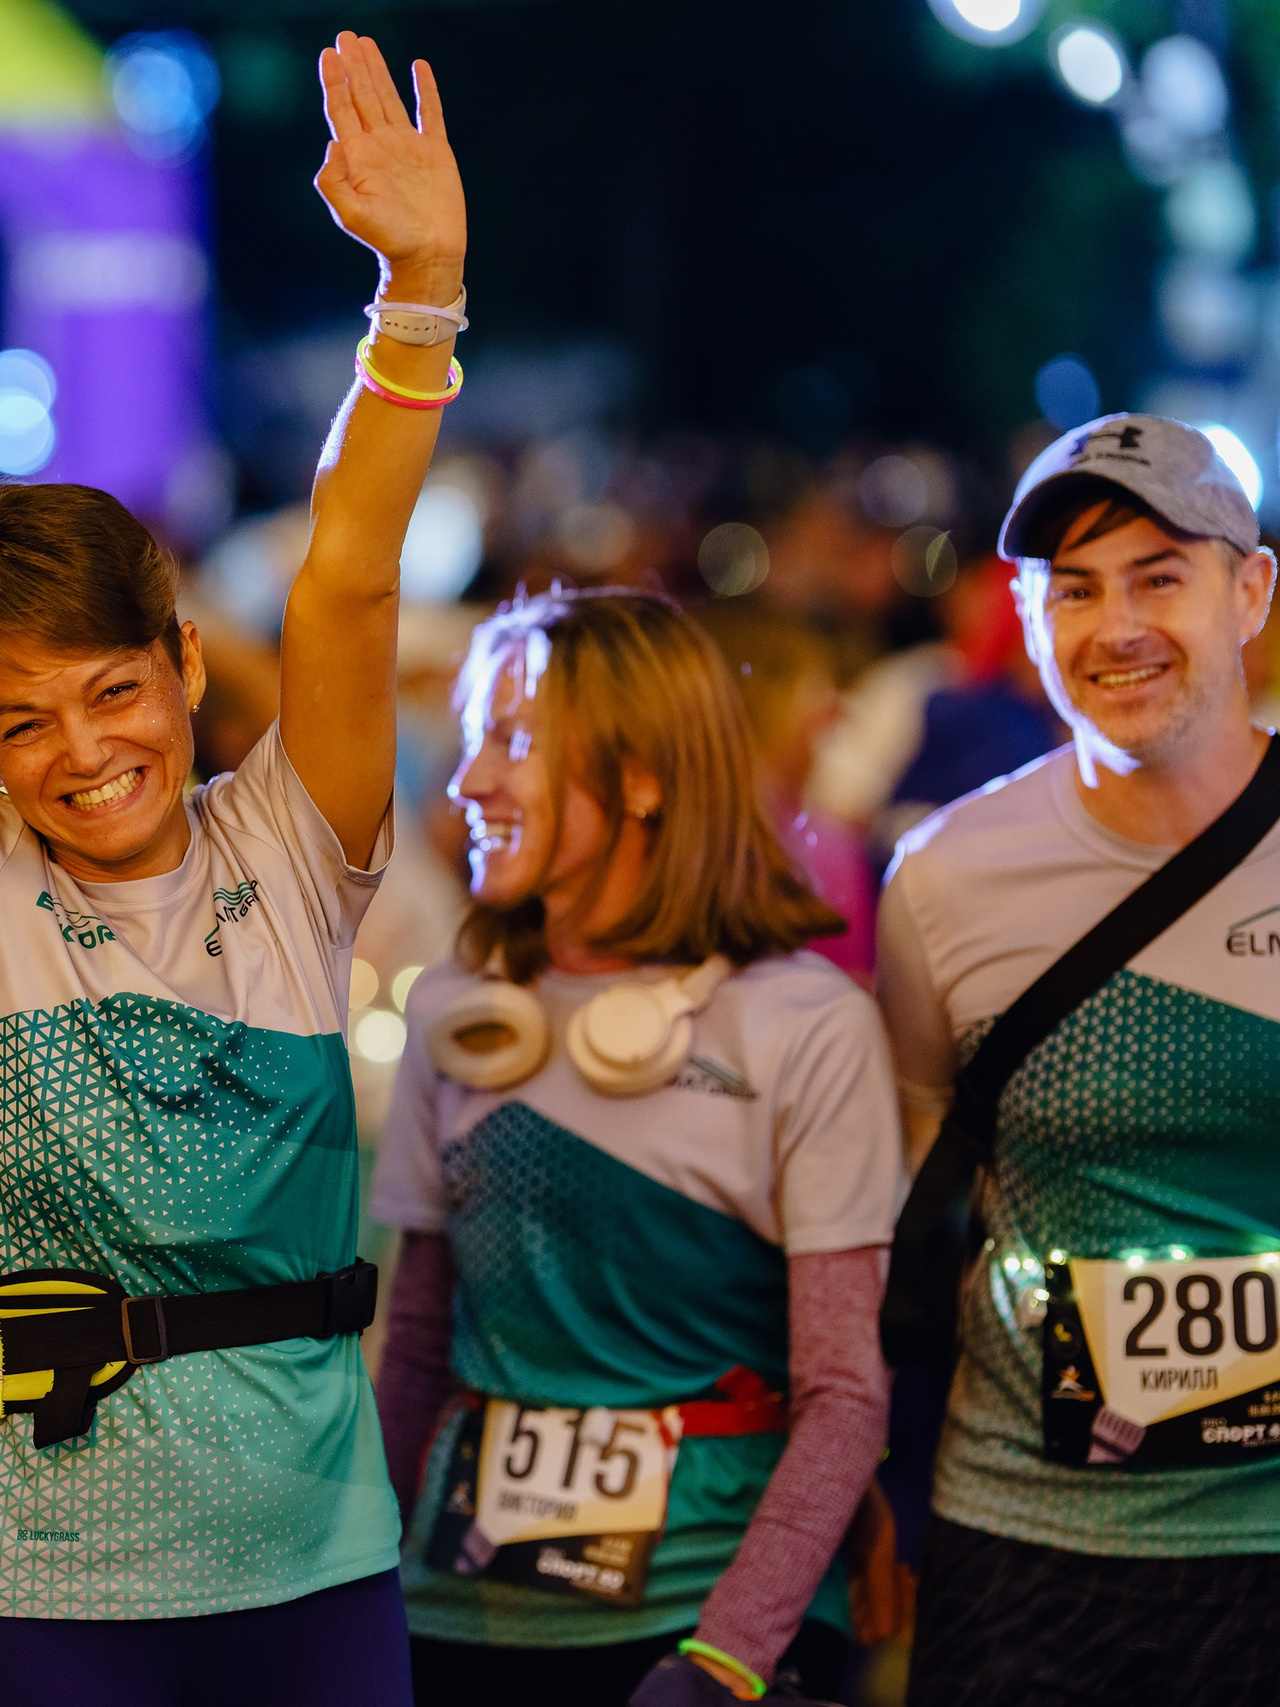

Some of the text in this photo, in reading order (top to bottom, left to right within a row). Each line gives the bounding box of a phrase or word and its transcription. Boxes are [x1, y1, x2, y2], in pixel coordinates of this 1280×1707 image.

[36, 891, 117, 950] EKOR
[1123, 1270, 1278, 1357] 280
[1140, 1367, 1218, 1391] КИРИЛЛ
[505, 1404, 647, 1501] 515
[30, 1530, 80, 1543] LUCKYGRASS
